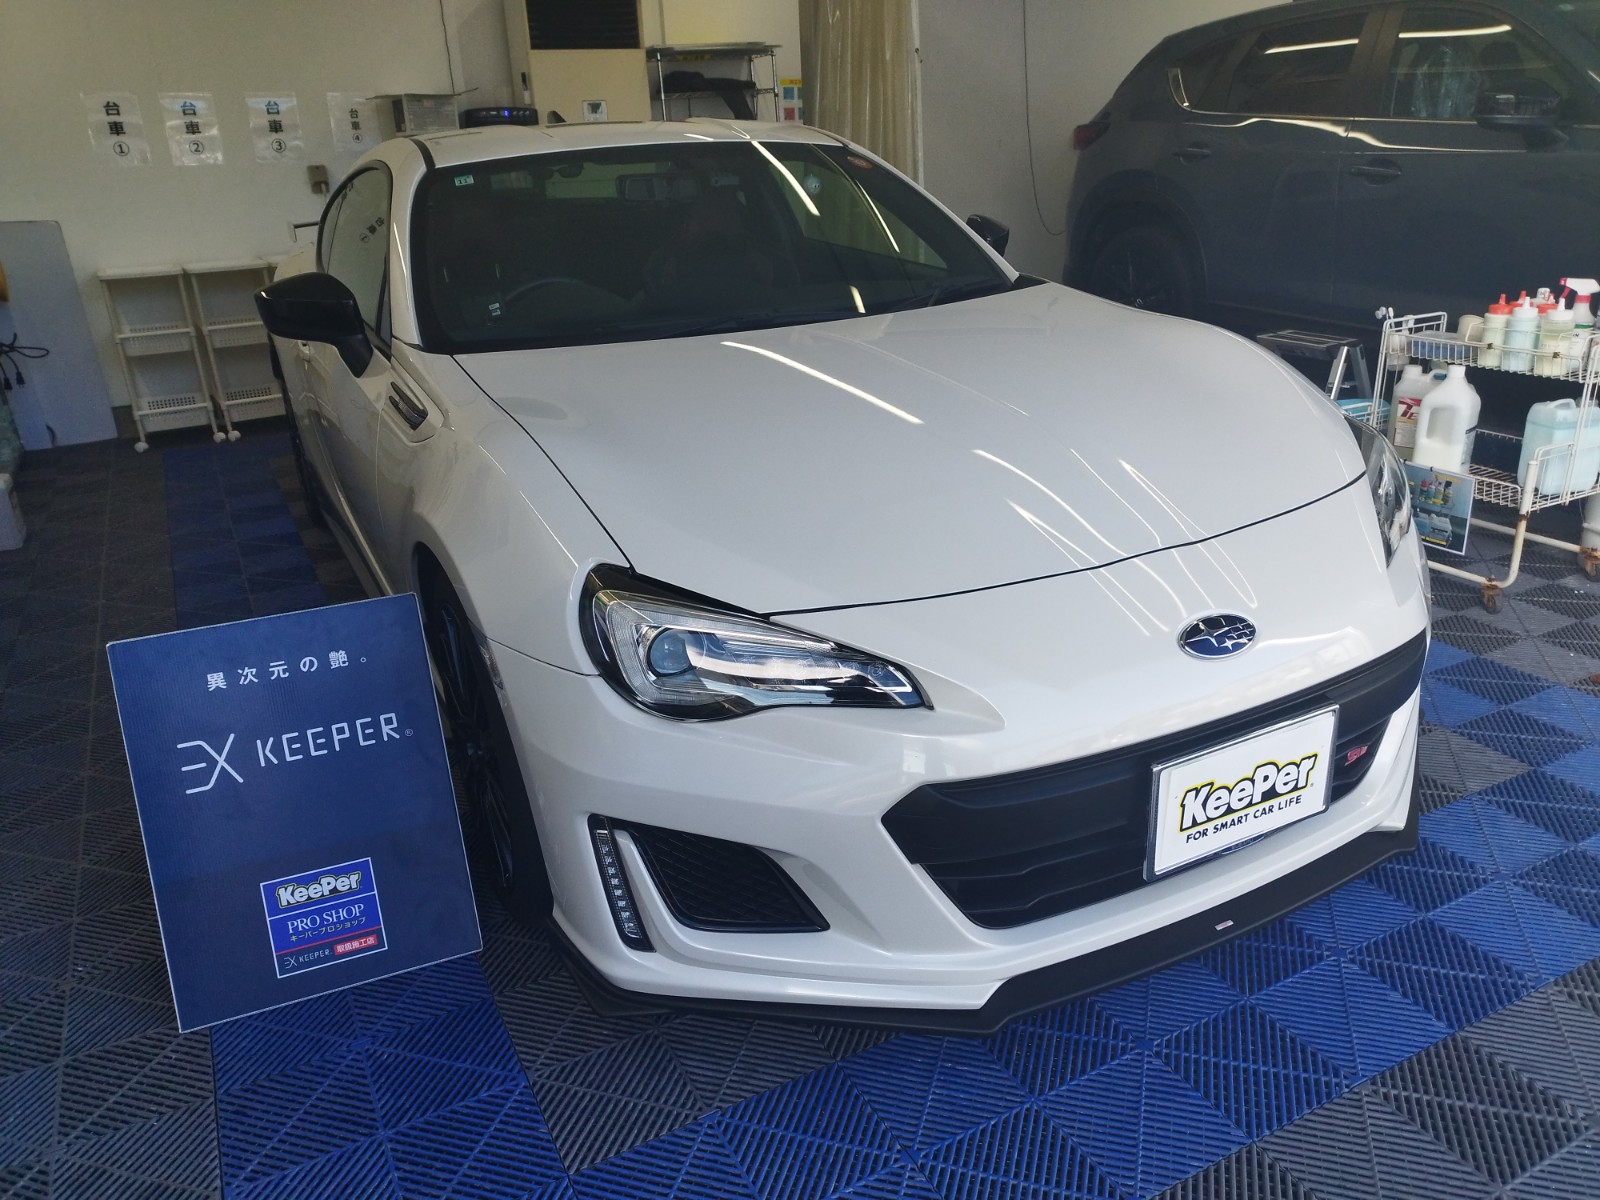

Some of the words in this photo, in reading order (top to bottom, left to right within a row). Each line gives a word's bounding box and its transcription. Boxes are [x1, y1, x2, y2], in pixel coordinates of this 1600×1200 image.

[1179, 753, 1319, 832] KeePer
[1185, 828, 1209, 844] FOR
[1212, 813, 1250, 833] SMART
[1253, 804, 1275, 820] CAR
[1277, 794, 1303, 811] LIFE
[276, 871, 361, 908] KeePer
[287, 915, 320, 934] PRO
[323, 903, 364, 925] SHOP
